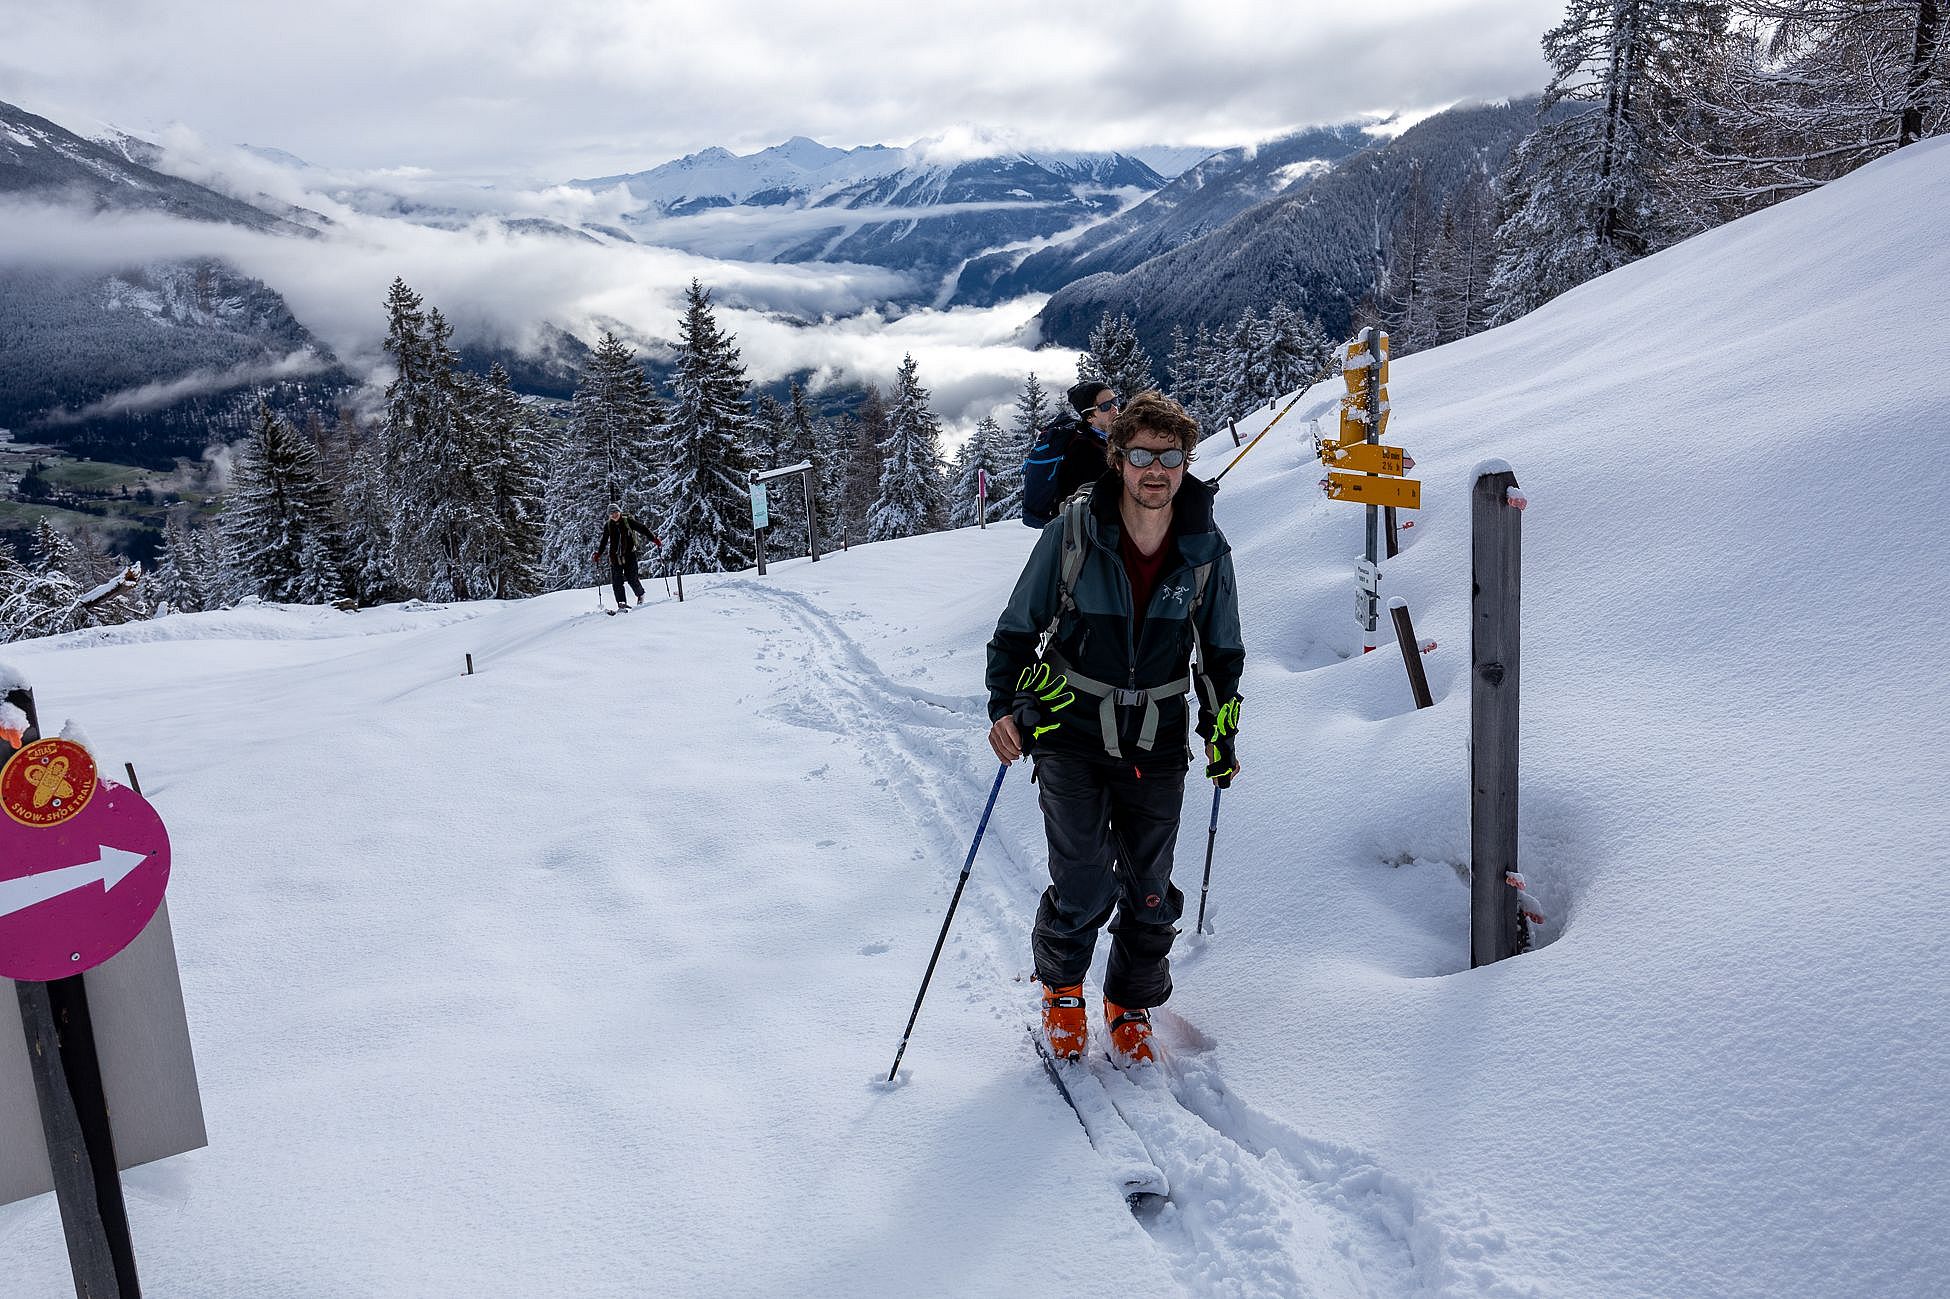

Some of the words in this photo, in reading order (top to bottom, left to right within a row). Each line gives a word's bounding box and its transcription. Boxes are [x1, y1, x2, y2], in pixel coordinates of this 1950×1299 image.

[34, 747, 52, 757] ATLAS
[12, 803, 75, 821] SNOW-SHOE
[73, 779, 92, 806] TRAIL
